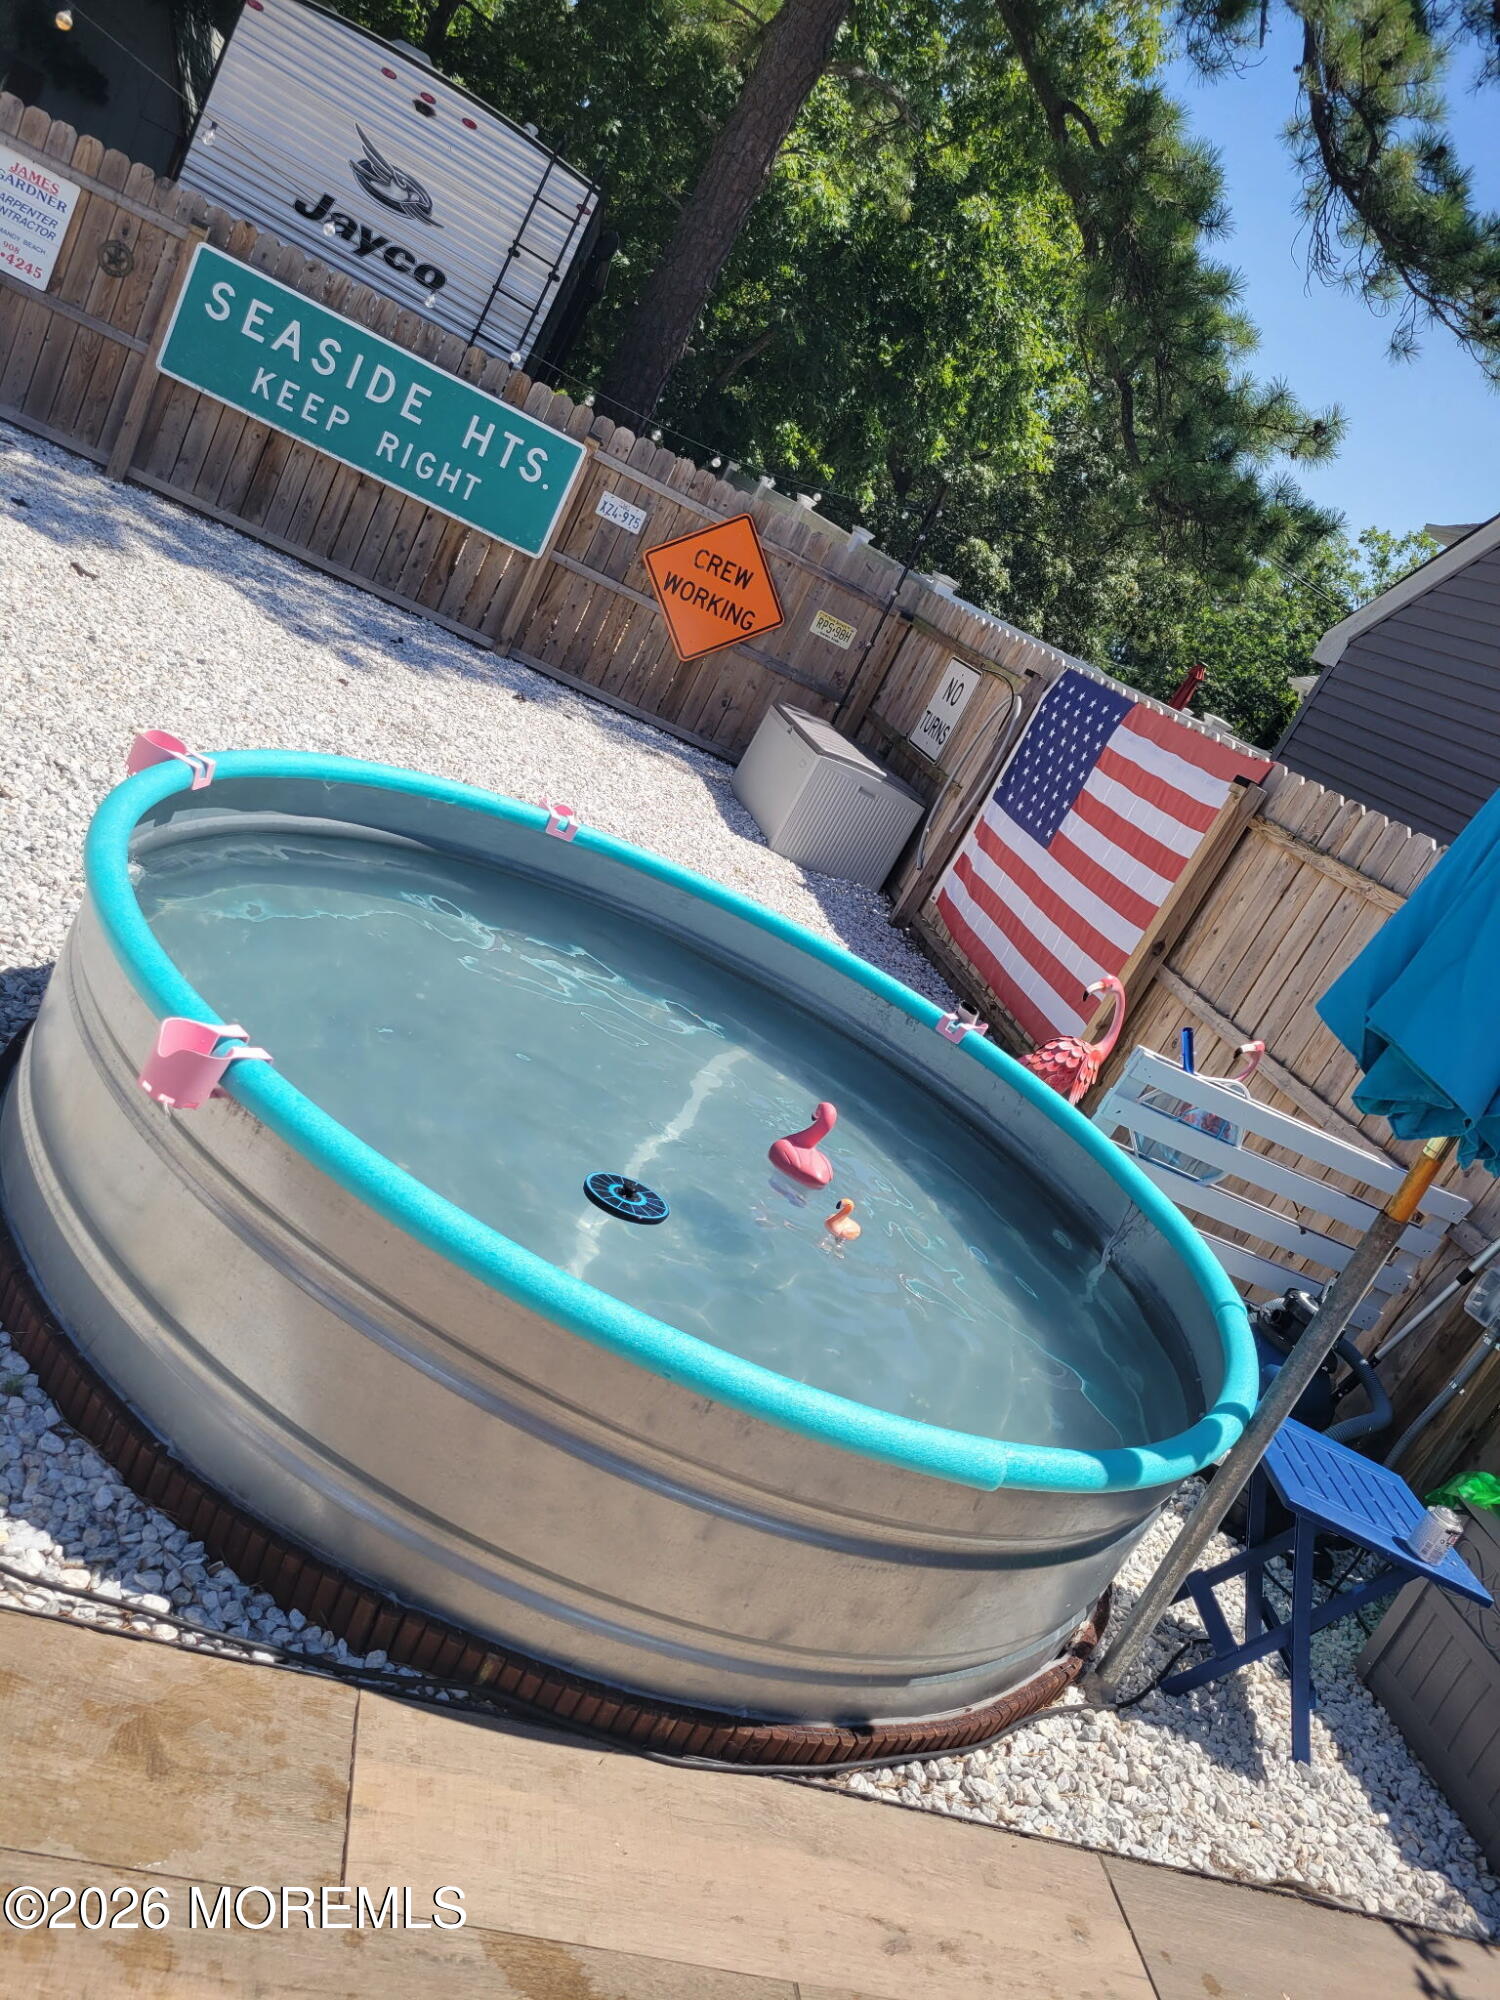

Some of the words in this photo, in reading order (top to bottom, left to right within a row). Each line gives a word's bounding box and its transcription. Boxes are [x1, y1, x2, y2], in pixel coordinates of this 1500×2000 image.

[9, 162, 60, 196] JAMES
[3, 240, 20, 254] 908
[294, 193, 447, 291] Jayco
[204, 282, 432, 425] SEASIDE
[461, 415, 550, 490] HTS.
[251, 366, 351, 432] KEEP
[375, 431, 482, 501] RIGHT
[694, 549, 754, 590] CREW
[663, 571, 756, 631] WORKING
[942, 676, 965, 707] NO
[919, 710, 951, 746] TURNS
